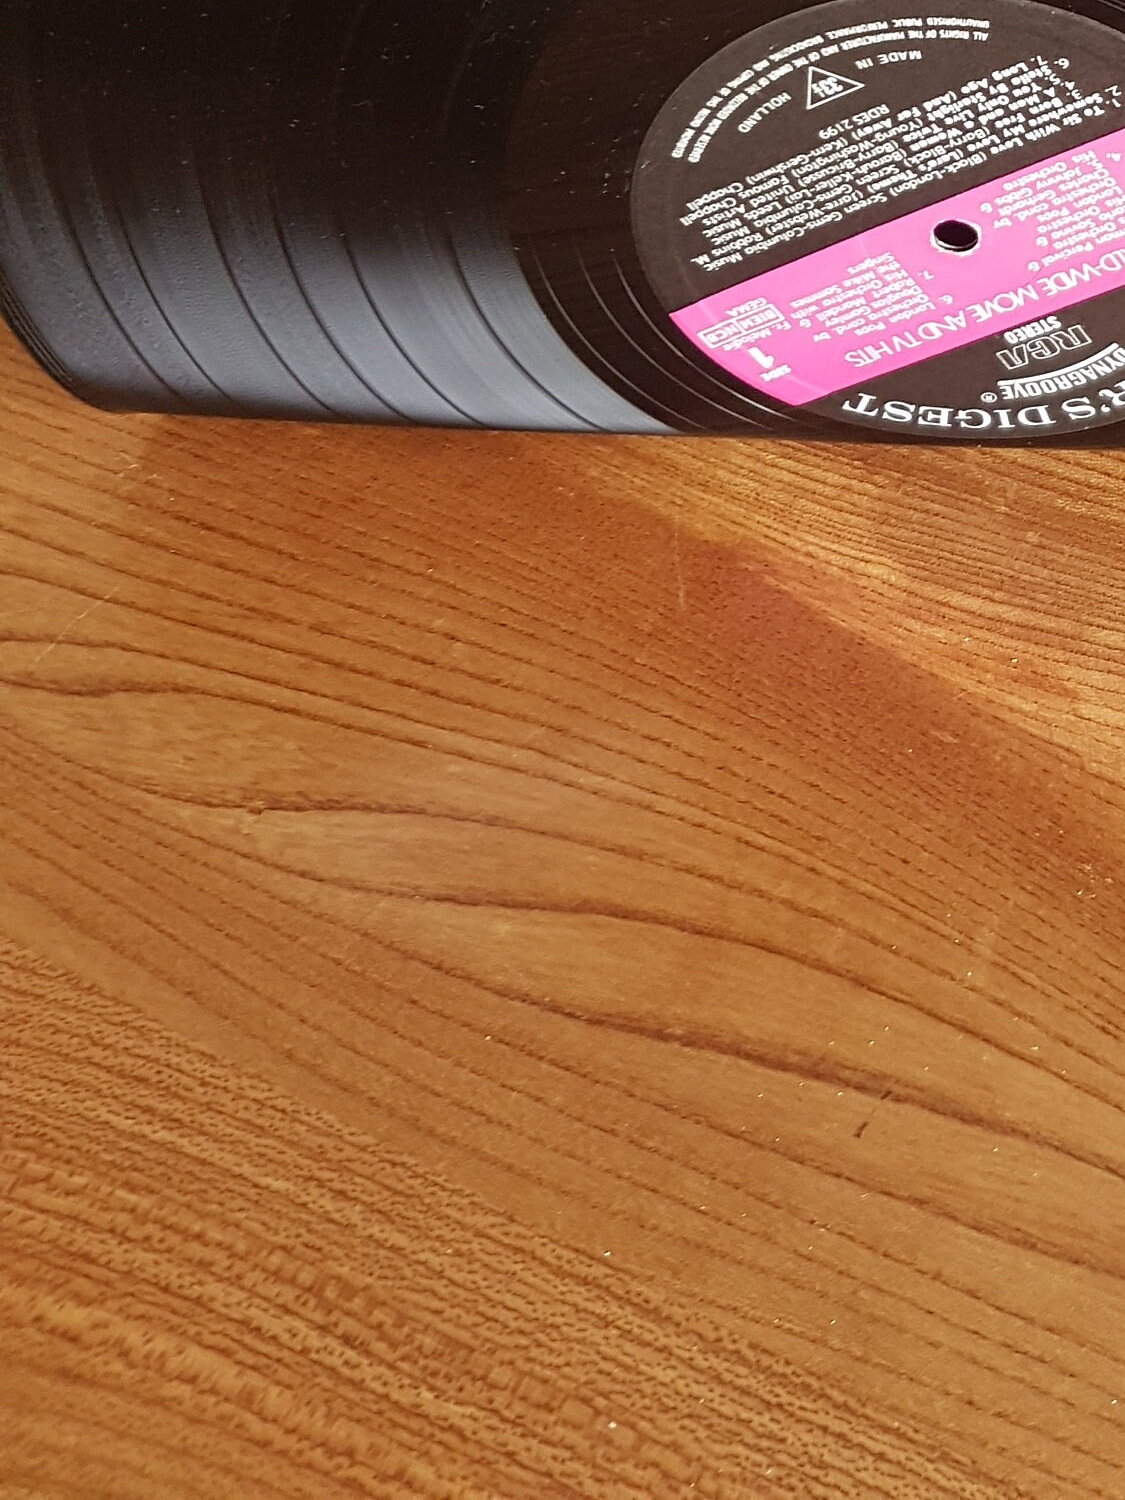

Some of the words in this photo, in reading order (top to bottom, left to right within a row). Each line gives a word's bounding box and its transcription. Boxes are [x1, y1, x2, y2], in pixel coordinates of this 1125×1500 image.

[907, 29, 924, 39] THE
[925, 28, 937, 39] OF
[938, 29, 970, 40] RIGHTS
[972, 30, 989, 41] ALL
[854, 57, 874, 70] IN
[876, 50, 922, 64] MADE
[1029, 55, 1048, 66] 7.
[1053, 57, 1070, 69] 6.
[991, 61, 1029, 81] Long
[1010, 64, 1052, 86] Stella
[1043, 72, 1061, 86] 5.
[960, 77, 993, 94] Ago
[988, 82, 1009, 95] By
[1011, 81, 1043, 97] You
[1042, 86, 1056, 98] A
[1059, 80, 1075, 91] 4.
[1065, 88, 1083, 100] 3.
[1104, 84, 1122, 97] 2.
[922, 90, 957, 112] (And
[926, 91, 987, 121] Starlight
[977, 94, 1010, 112] Only
[1007, 93, 1041, 111] Man
[1027, 92, 1103, 127] Somewhere
[1028, 96, 1064, 115] Born
[1083, 104, 1105, 117] To
[1105, 98, 1121, 108] 1.
[737, 92, 791, 133] HOLLAND
[851, 103, 890, 126] RDES
[896, 106, 922, 121] Far
[943, 108, 975, 125] Live
[977, 107, 1005, 126] and
[994, 112, 1026, 131] Free
[1062, 112, 1083, 126] Sir
[818, 118, 854, 140] 2199
[850, 117, 892, 141] Away)
[901, 122, 943, 143] Twice
[962, 120, 975, 129] a
[1002, 123, 1026, 138] My
[1024, 123, 1061, 141] With
[790, 117, 923, 178] (Young-Washington)
[903, 125, 990, 168] (Barry-Black)
[909, 127, 963, 152] Woman
[966, 134, 1001, 152] Love
[989, 136, 1024, 155] Love
[745, 136, 848, 185] (Kern-Gershwin)
[797, 139, 899, 187] (Barry-Bricusse)
[917, 148, 964, 172] (Lara's
[1071, 149, 1097, 163] His
[855, 163, 900, 185] Screen
[866, 169, 918, 194] Theme)
[889, 151, 987, 196] (Black-London)
[1002, 161, 1067, 191] Orchestra
[1035, 166, 1082, 190] Johnny
[1058, 167, 1109, 192] Charles
[685, 182, 744, 211] Chappell
[737, 174, 790, 199] Famous
[748, 184, 795, 208] United
[993, 187, 1033, 205] Gibbs
[1051, 176, 1116, 206] Orchestra
[1072, 185, 1123, 208] London
[679, 197, 737, 226] Chappell
[742, 200, 783, 220] Leeds
[753, 183, 853, 228] Gems-Columbia
[764, 189, 864, 236] (Jarre-Webster)
[843, 192, 888, 214] Screen
[979, 202, 993, 213] &
[1013, 202, 1049, 221] cond.
[701, 203, 746, 226] Artists
[993, 217, 1012, 229] by
[1036, 206, 1070, 222] Pops
[1036, 205, 1101, 233] Orchestra
[701, 217, 742, 238] Music
[710, 225, 751, 246] Music
[743, 211, 843, 255] Gems-Columbia
[1050, 217, 1096, 239] Savina
[1052, 221, 1117, 250] Orchestra
[711, 232, 764, 257] Robbins
[1035, 236, 1049, 247] &
[689, 253, 711, 265] M.
[702, 251, 743, 271] Music
[846, 251, 894, 275] Singers
[1041, 241, 1094, 267] Percival
[876, 260, 900, 274] the
[882, 268, 908, 282] His
[917, 270, 934, 280] 7.
[1027, 261, 1040, 272] &
[842, 270, 876, 287] Mike
[871, 277, 915, 299] Robert
[789, 284, 842, 308] Sammes
[821, 279, 883, 307] Orchestra
[870, 284, 923, 309] Douglas
[938, 294, 953, 305] 6.
[725, 297, 767, 317] GEMA
[738, 306, 779, 329] BIEM
[789, 304, 819, 319] with
[815, 296, 866, 322] Mandell
[824, 305, 872, 327] Gamley
[867, 293, 929, 321] Orchestra
[888, 301, 936, 323] London
[705, 322, 740, 343] NCB
[771, 320, 792, 330] Fr.
[799, 318, 812, 328] &
[831, 317, 866, 335] cond.
[853, 321, 886, 336] Pops
[917, 310, 966, 340] AND
[1003, 315, 1062, 345] STEREO
[718, 327, 772, 351] Melodie
[812, 331, 832, 342] by
[891, 331, 923, 352] TV
[995, 324, 1092, 370] RCA
[747, 346, 774, 369] 1
[844, 340, 894, 367] HITS
[759, 364, 791, 382] SIDE
[842, 393, 1056, 429] DIGEST
